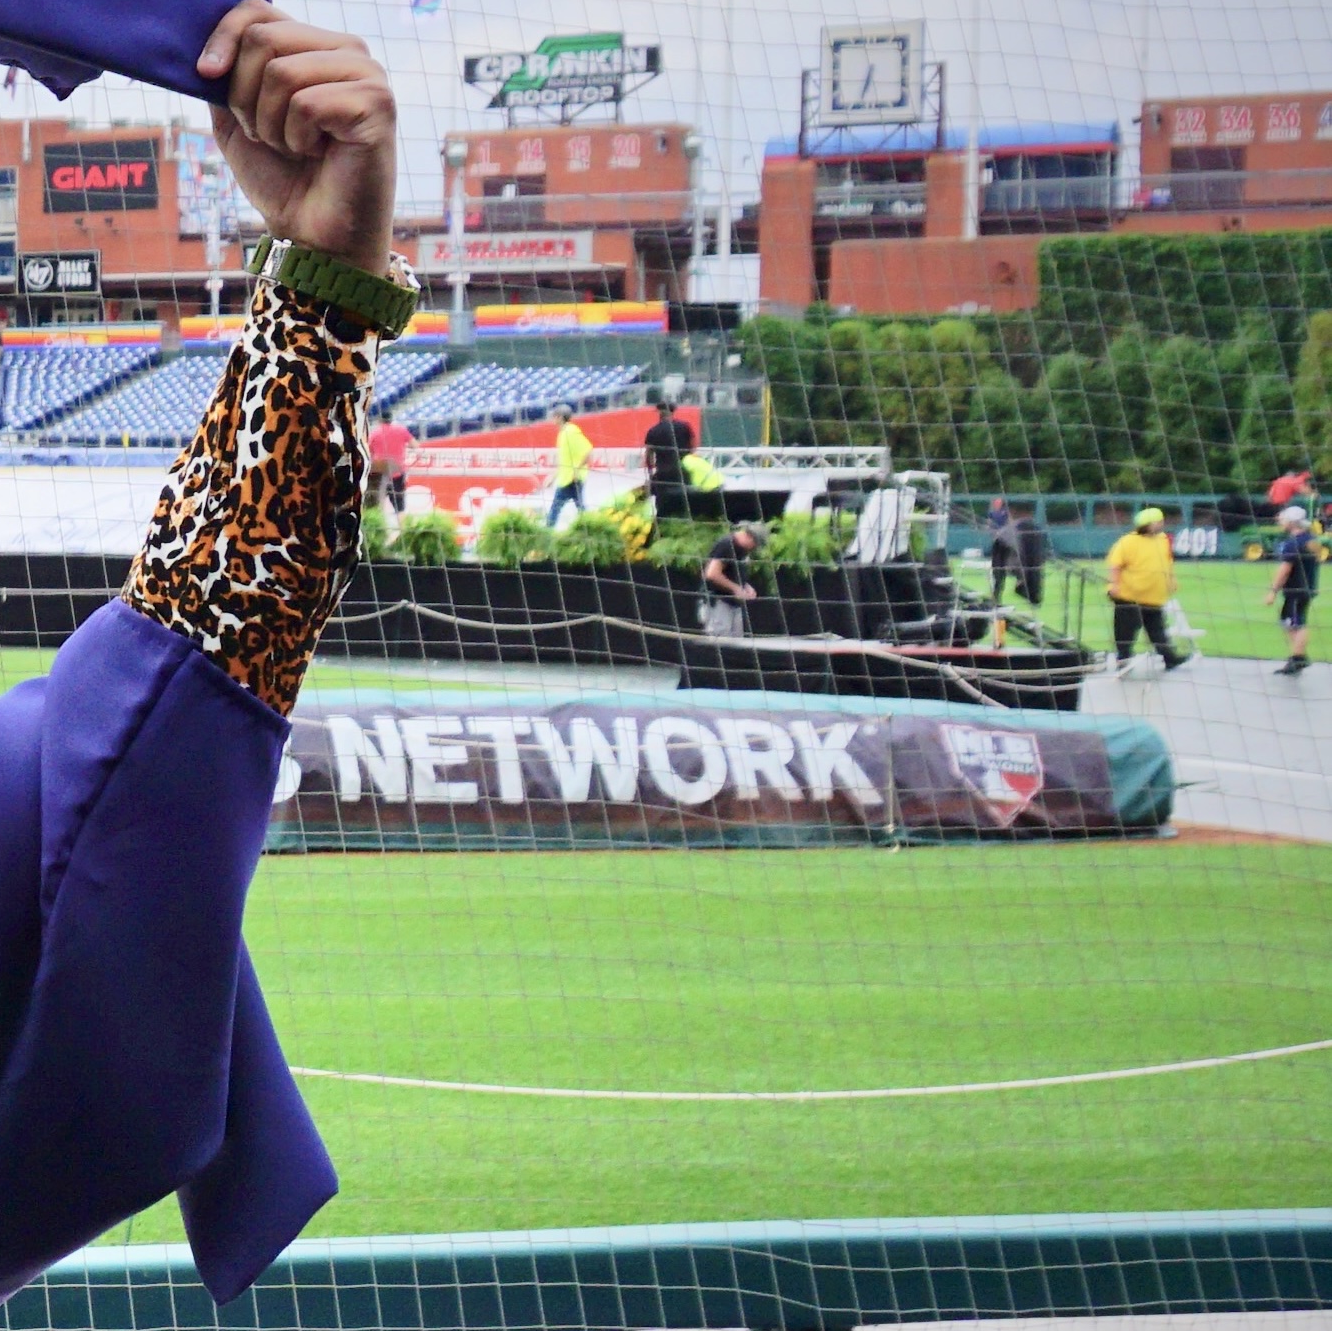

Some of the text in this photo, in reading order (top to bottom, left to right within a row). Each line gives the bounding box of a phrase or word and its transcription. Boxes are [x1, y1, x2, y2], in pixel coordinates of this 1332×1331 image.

[474, 54, 523, 82] CP
[505, 85, 615, 106] ROOFTOP
[51, 161, 150, 190] GIANT
[1174, 527, 1219, 556] 401
[328, 713, 885, 805] NETWORK
